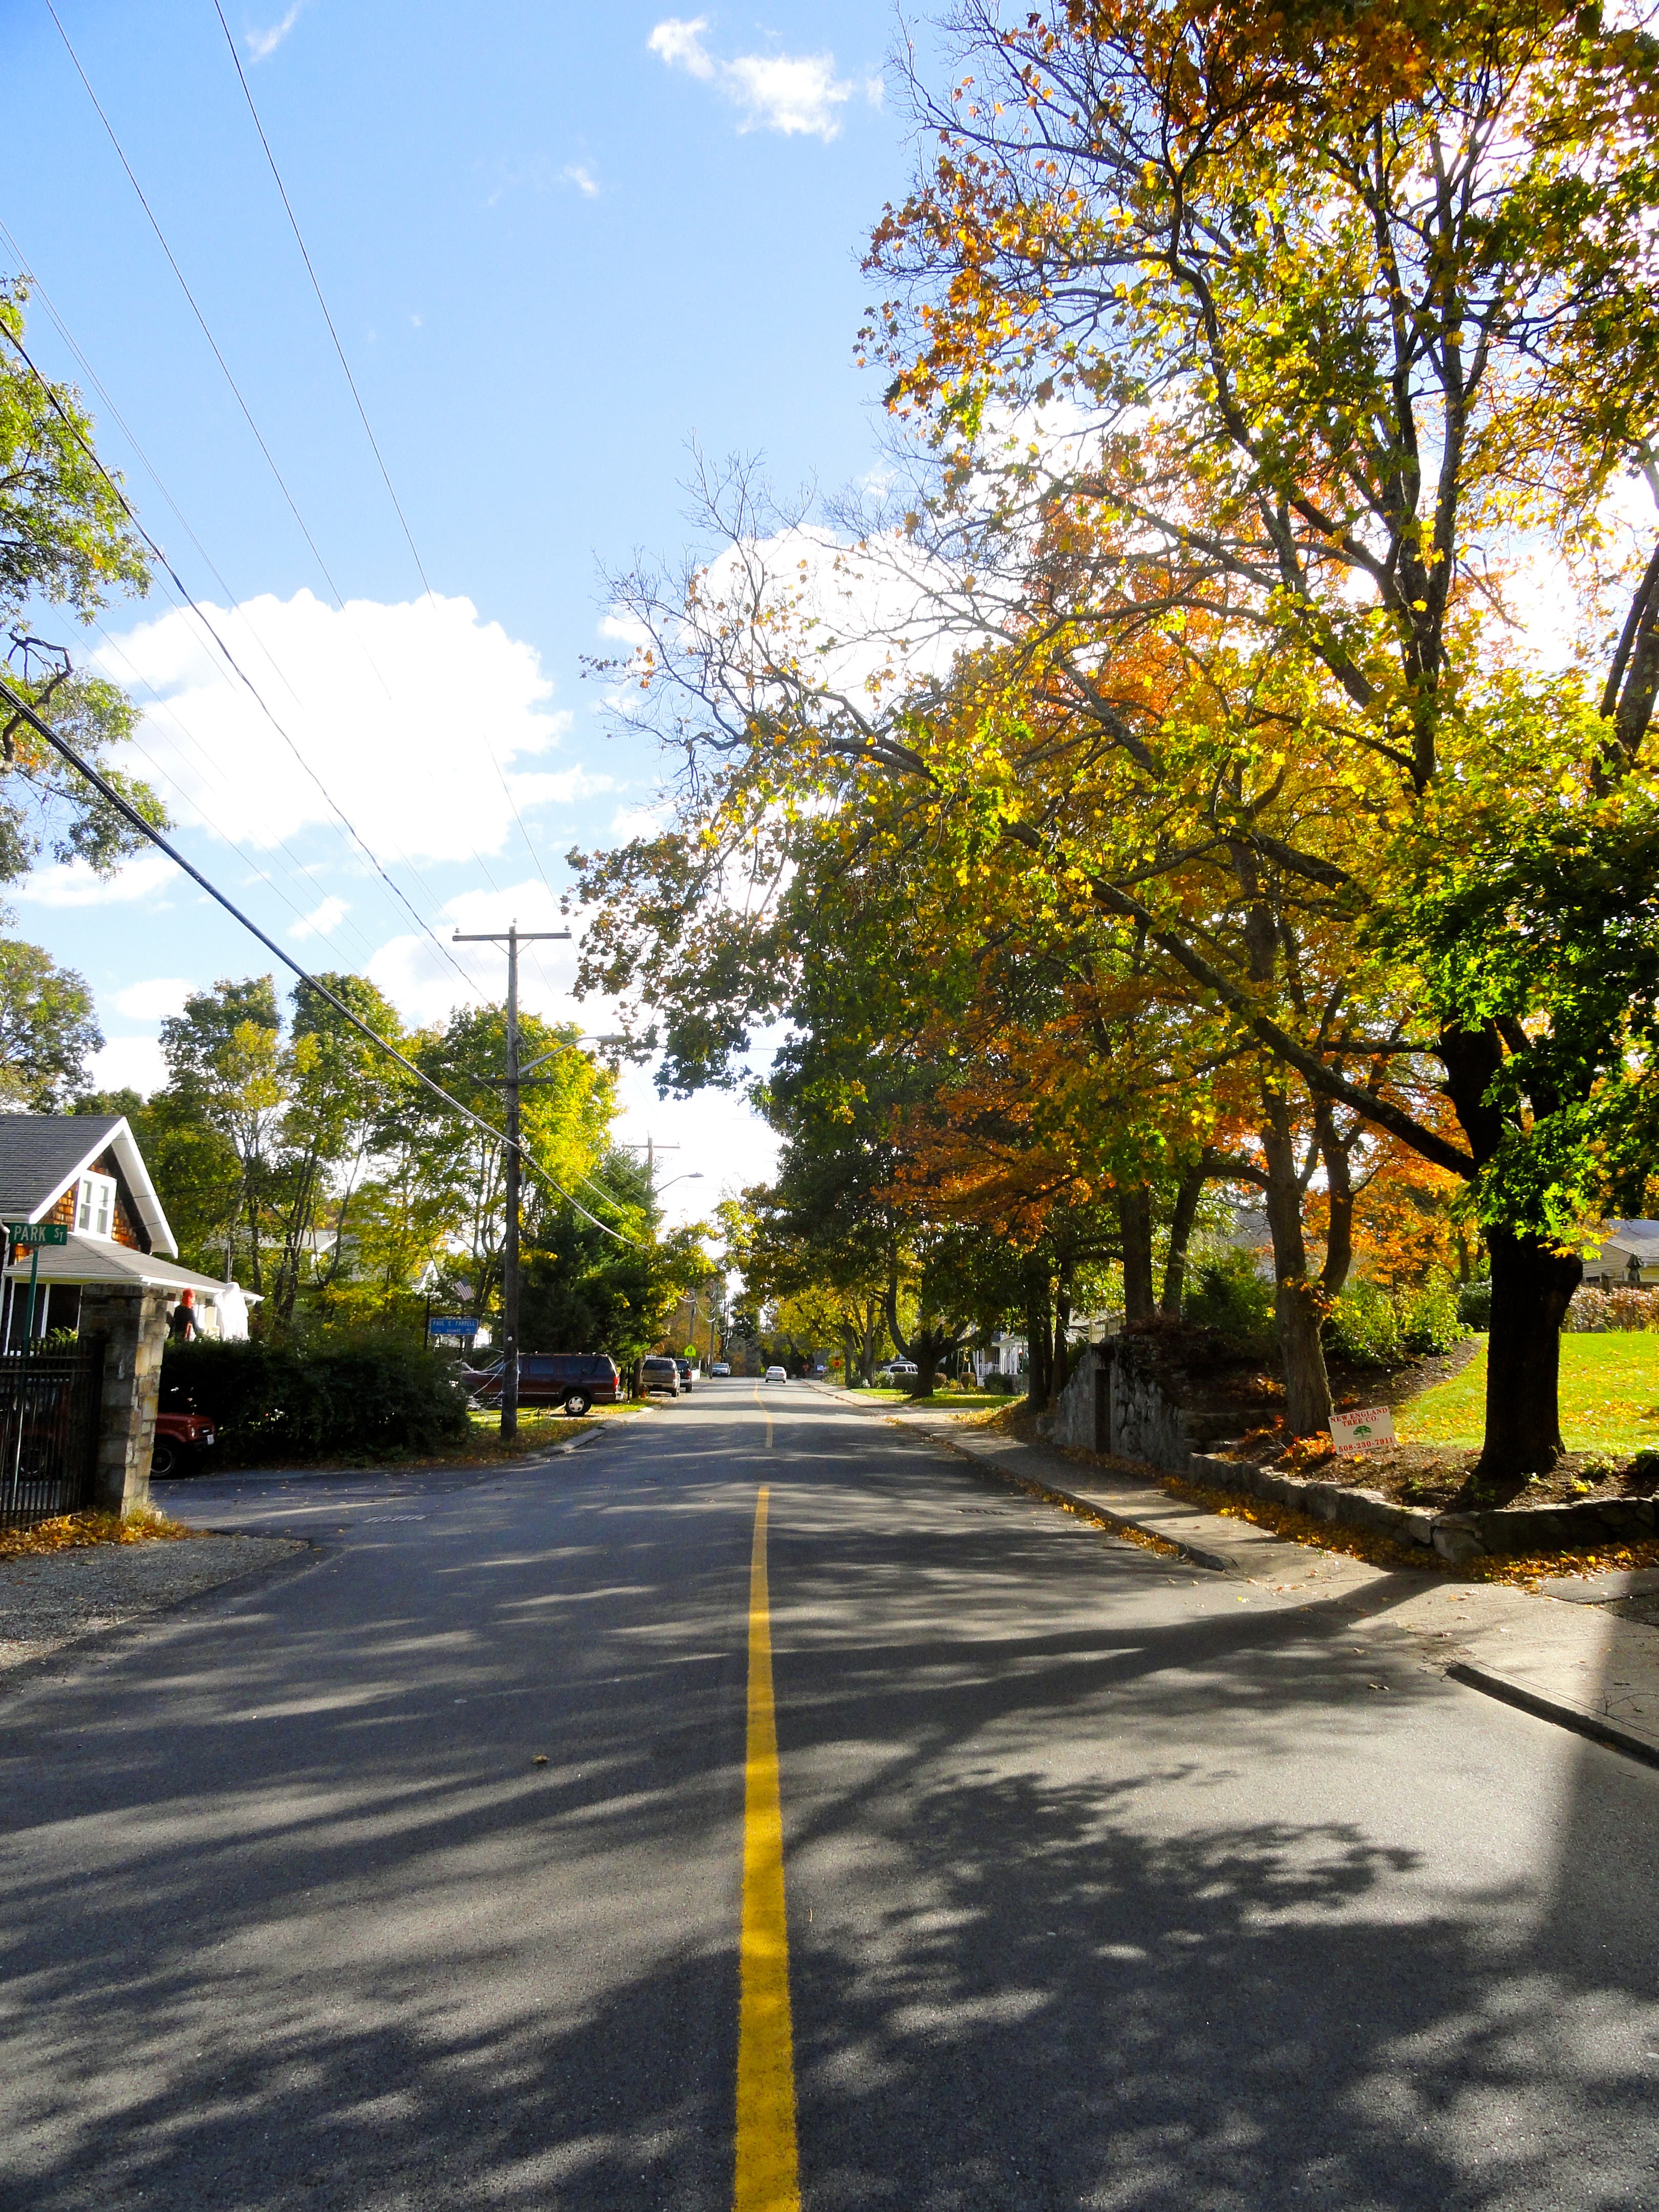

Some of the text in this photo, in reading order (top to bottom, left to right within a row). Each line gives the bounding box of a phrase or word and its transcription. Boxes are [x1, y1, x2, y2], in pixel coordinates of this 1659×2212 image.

[14, 1225, 46, 1242] PARK
[1330, 1408, 1388, 1423] NEW ENGLAND
[1342, 1419, 1364, 1427] TREE
[1338, 1437, 1393, 1452] 508-230-7911
